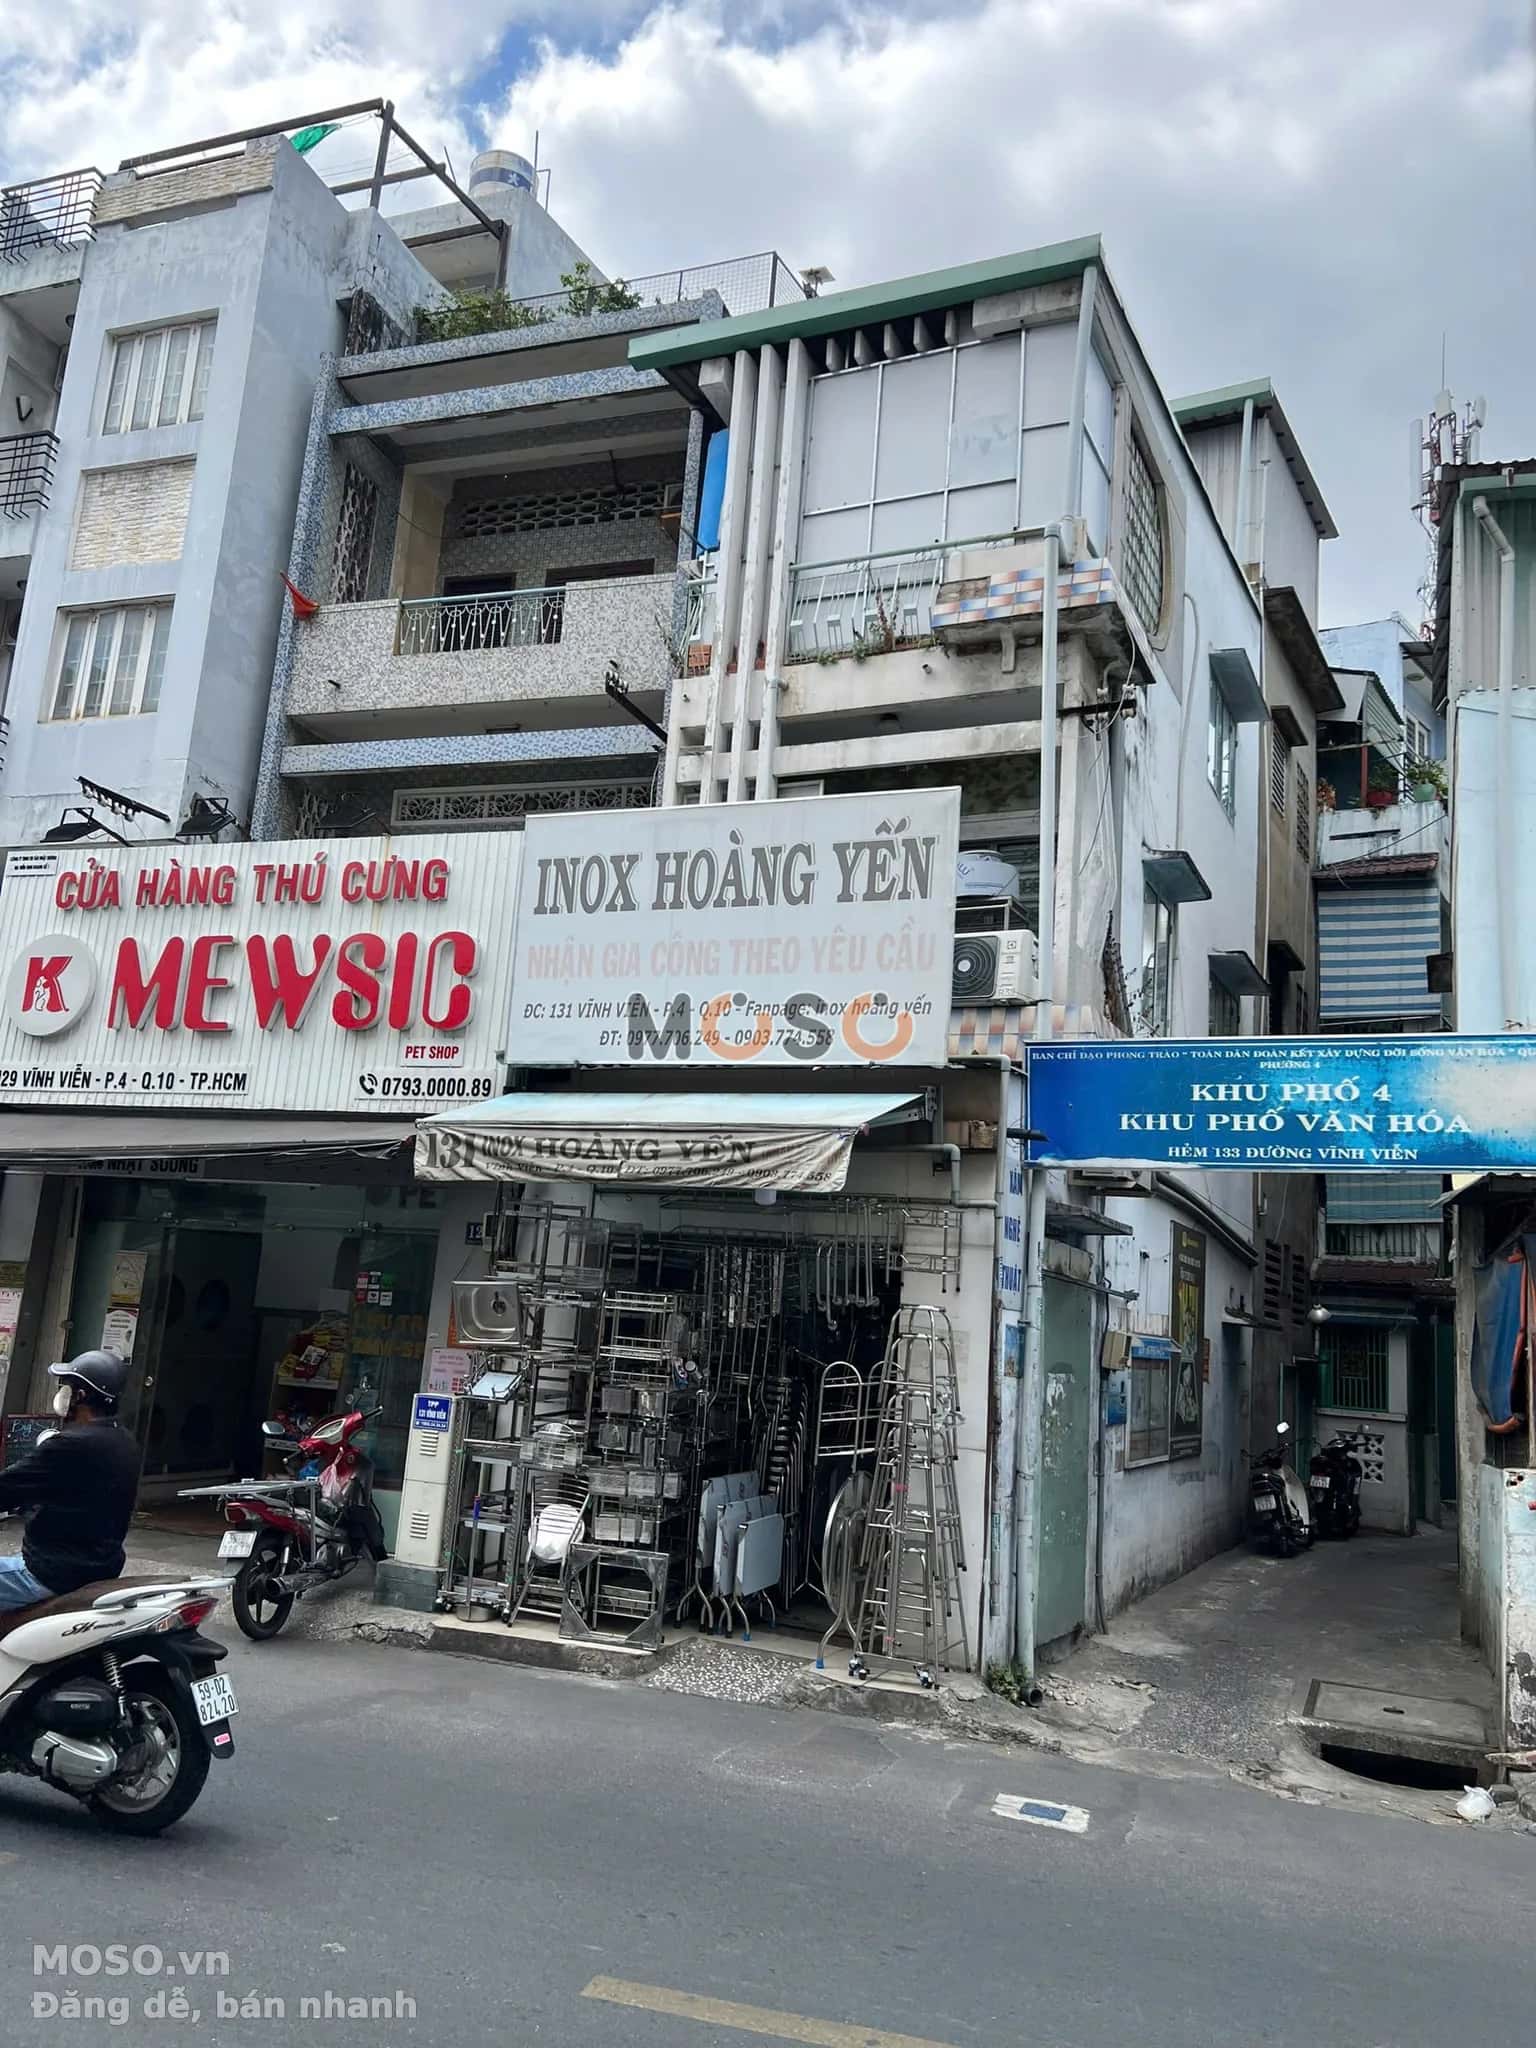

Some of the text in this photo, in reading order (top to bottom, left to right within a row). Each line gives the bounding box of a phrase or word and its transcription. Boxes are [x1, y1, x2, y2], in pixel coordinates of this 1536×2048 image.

[533, 816, 939, 915] INOX HOÀNG YẾN
[55, 851, 451, 910] CỬA HÀNG THÚ CƯNG
[527, 915, 936, 985] NHẬN GIA CÔNG THEO YÊU CẦU
[107, 931, 479, 1031] MEWSIC
[523, 1003, 546, 1019] ĐC:
[550, 1003, 573, 1018] 131
[578, 998, 611, 1018] VĨNH
[699, 1001, 731, 1020] Q.10
[745, 1000, 811, 1020] Fanpage:
[903, 994, 933, 1019] yến
[600, 1030, 622, 1047] ĐT:
[405, 1045, 459, 1060] PET SHOP
[1032, 1051, 1057, 1060] BAN
[1106, 1051, 1146, 1061] PHONG
[23, 1067, 54, 1088] VĨNH
[59, 1064, 92, 1088] VIỄN
[104, 1072, 127, 1089] P.4
[142, 1072, 175, 1090] Q.10
[190, 1072, 247, 1091] TP.HCM
[381, 1078, 492, 1098] 0793.0000.89
[1191, 1075, 1392, 1102] KHU PHỐ 4
[1119, 1106, 1473, 1134] KHU PHỐ VĂN HÓA
[425, 1132, 475, 1169] 131
[1168, 1142, 1418, 1161] HẺM 133 ĐƯỜNG VĨNH VIỄN
